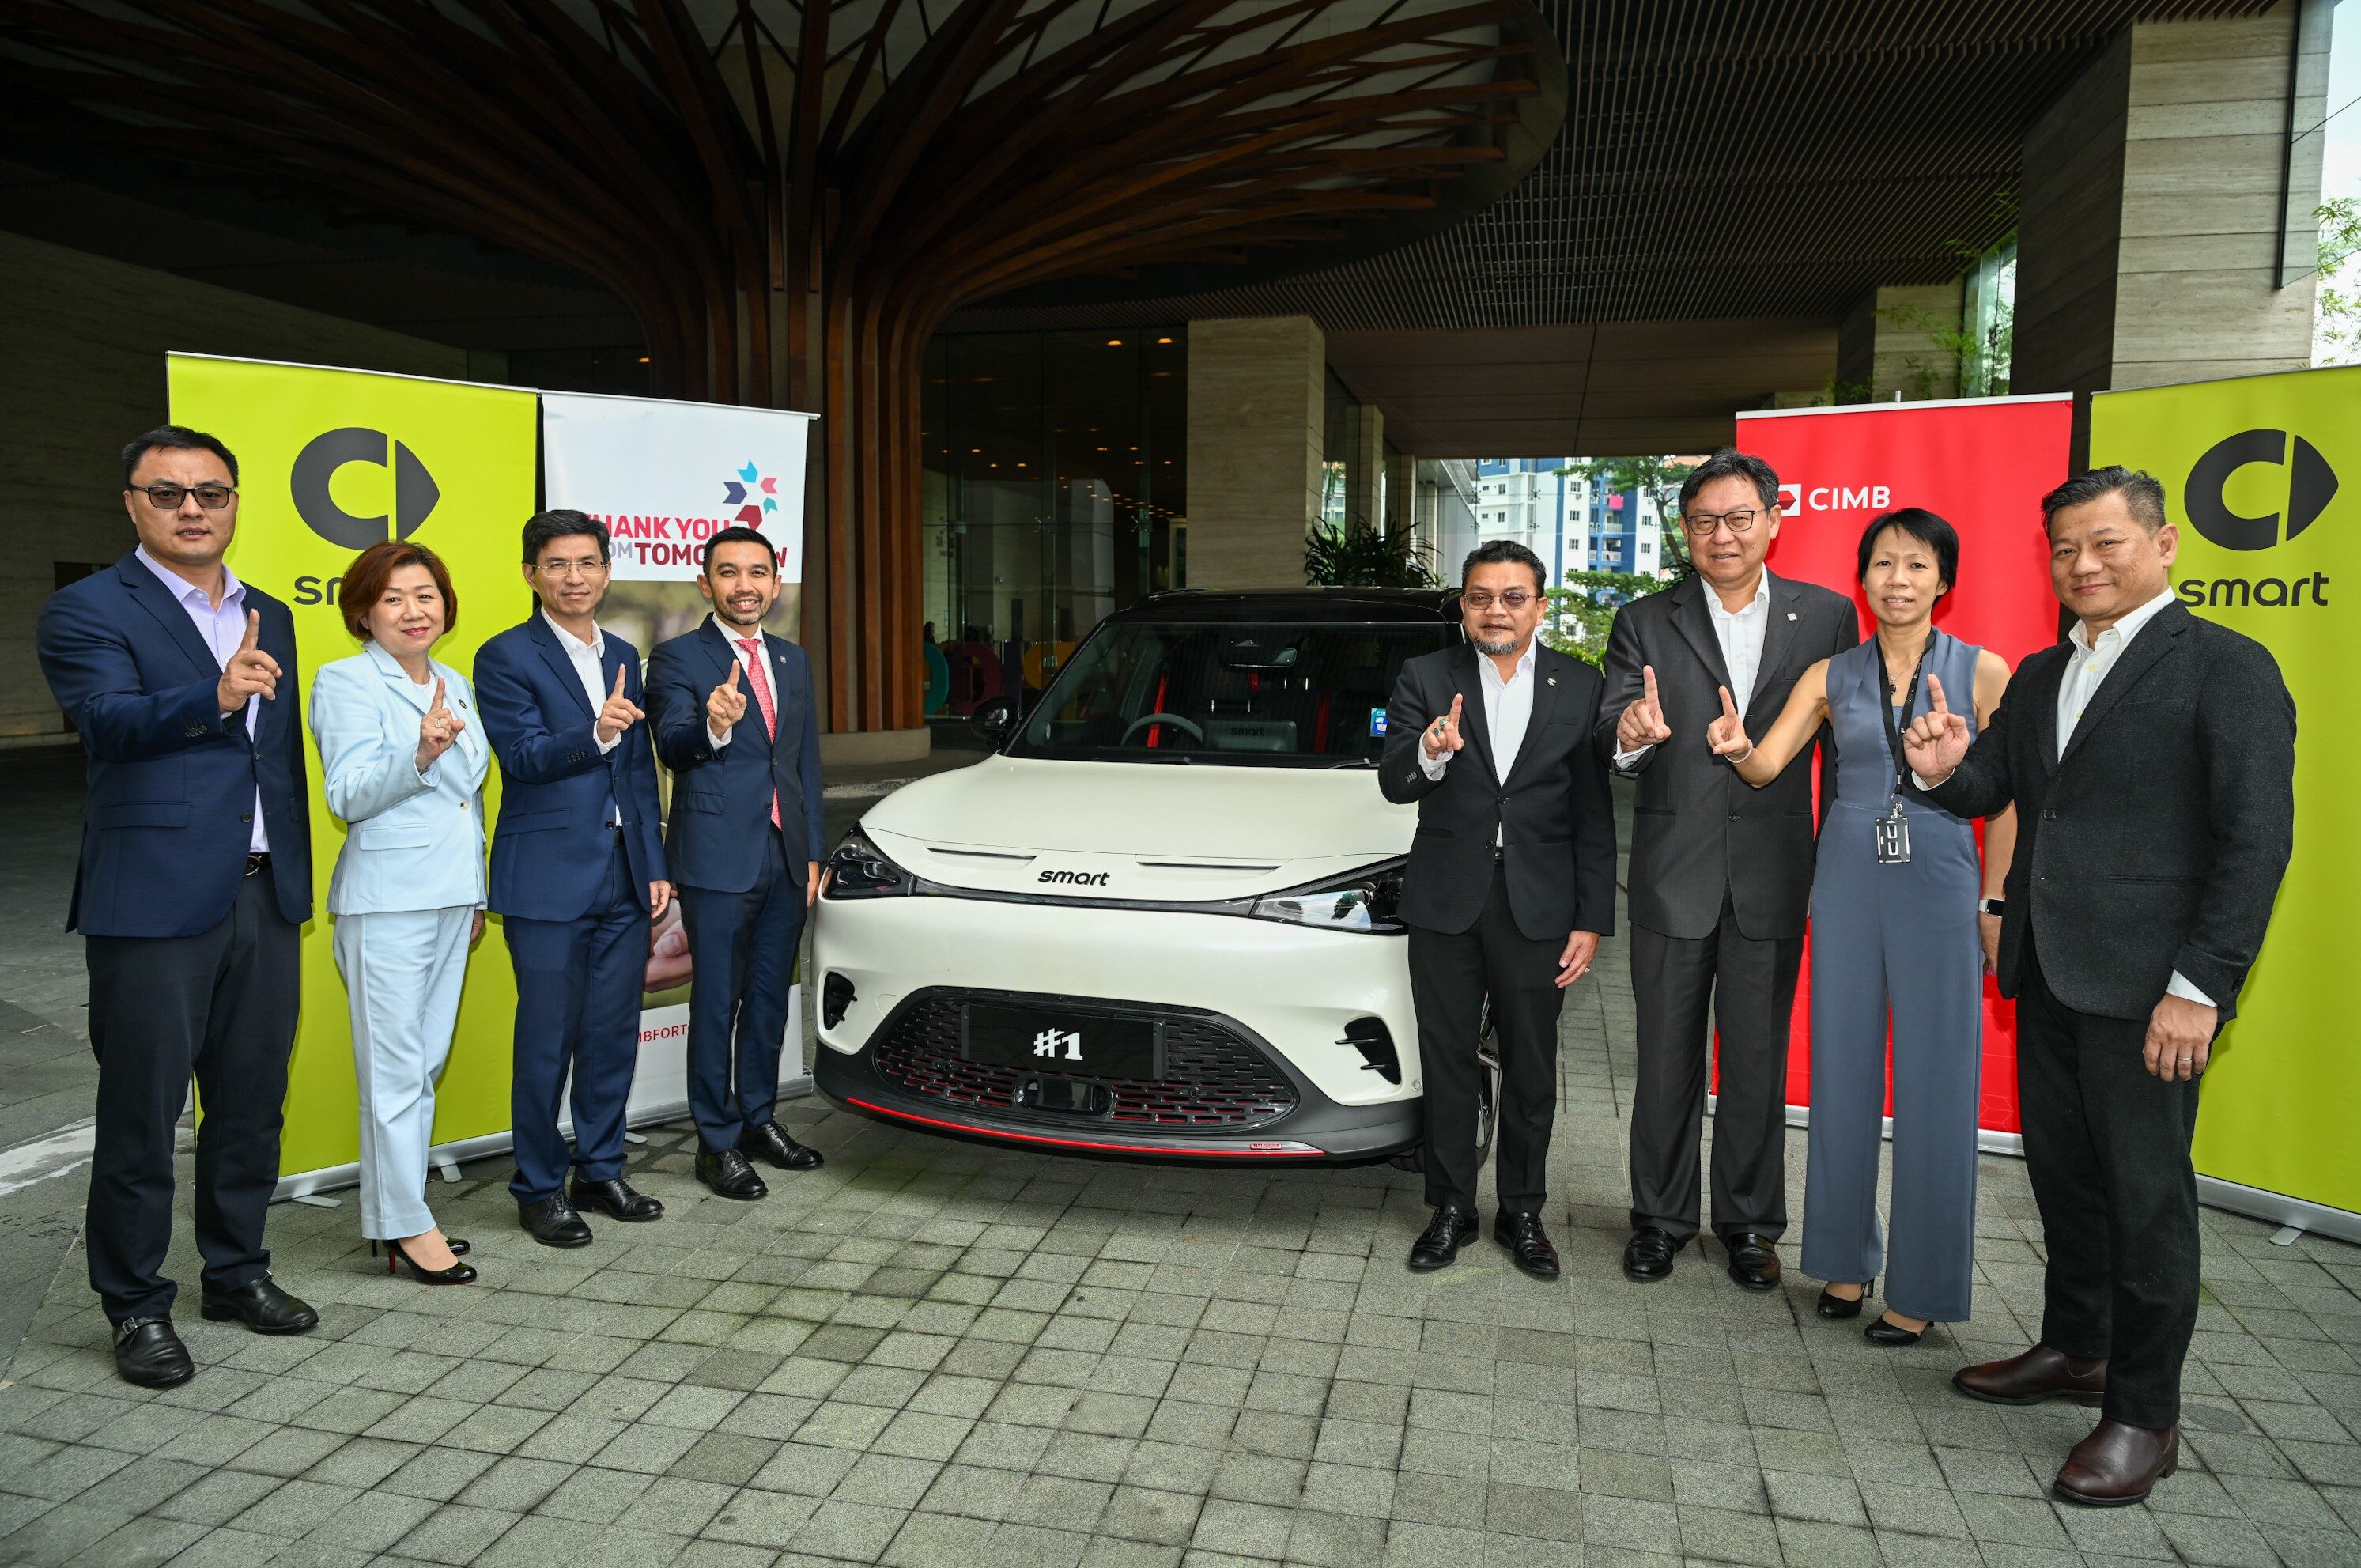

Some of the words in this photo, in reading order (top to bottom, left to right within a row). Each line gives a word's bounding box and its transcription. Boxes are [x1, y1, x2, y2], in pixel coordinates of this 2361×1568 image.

[1808, 486, 1891, 512] CIMB
[587, 514, 671, 539] ANK
[674, 518, 730, 541] YOU
[634, 542, 788, 568] TOMOW
[2178, 572, 2329, 607] smart
[1230, 726, 1264, 737] smart
[1037, 870, 1110, 887] smart
[638, 1023, 688, 1043] BFORT
[1033, 1027, 1083, 1061] #1
